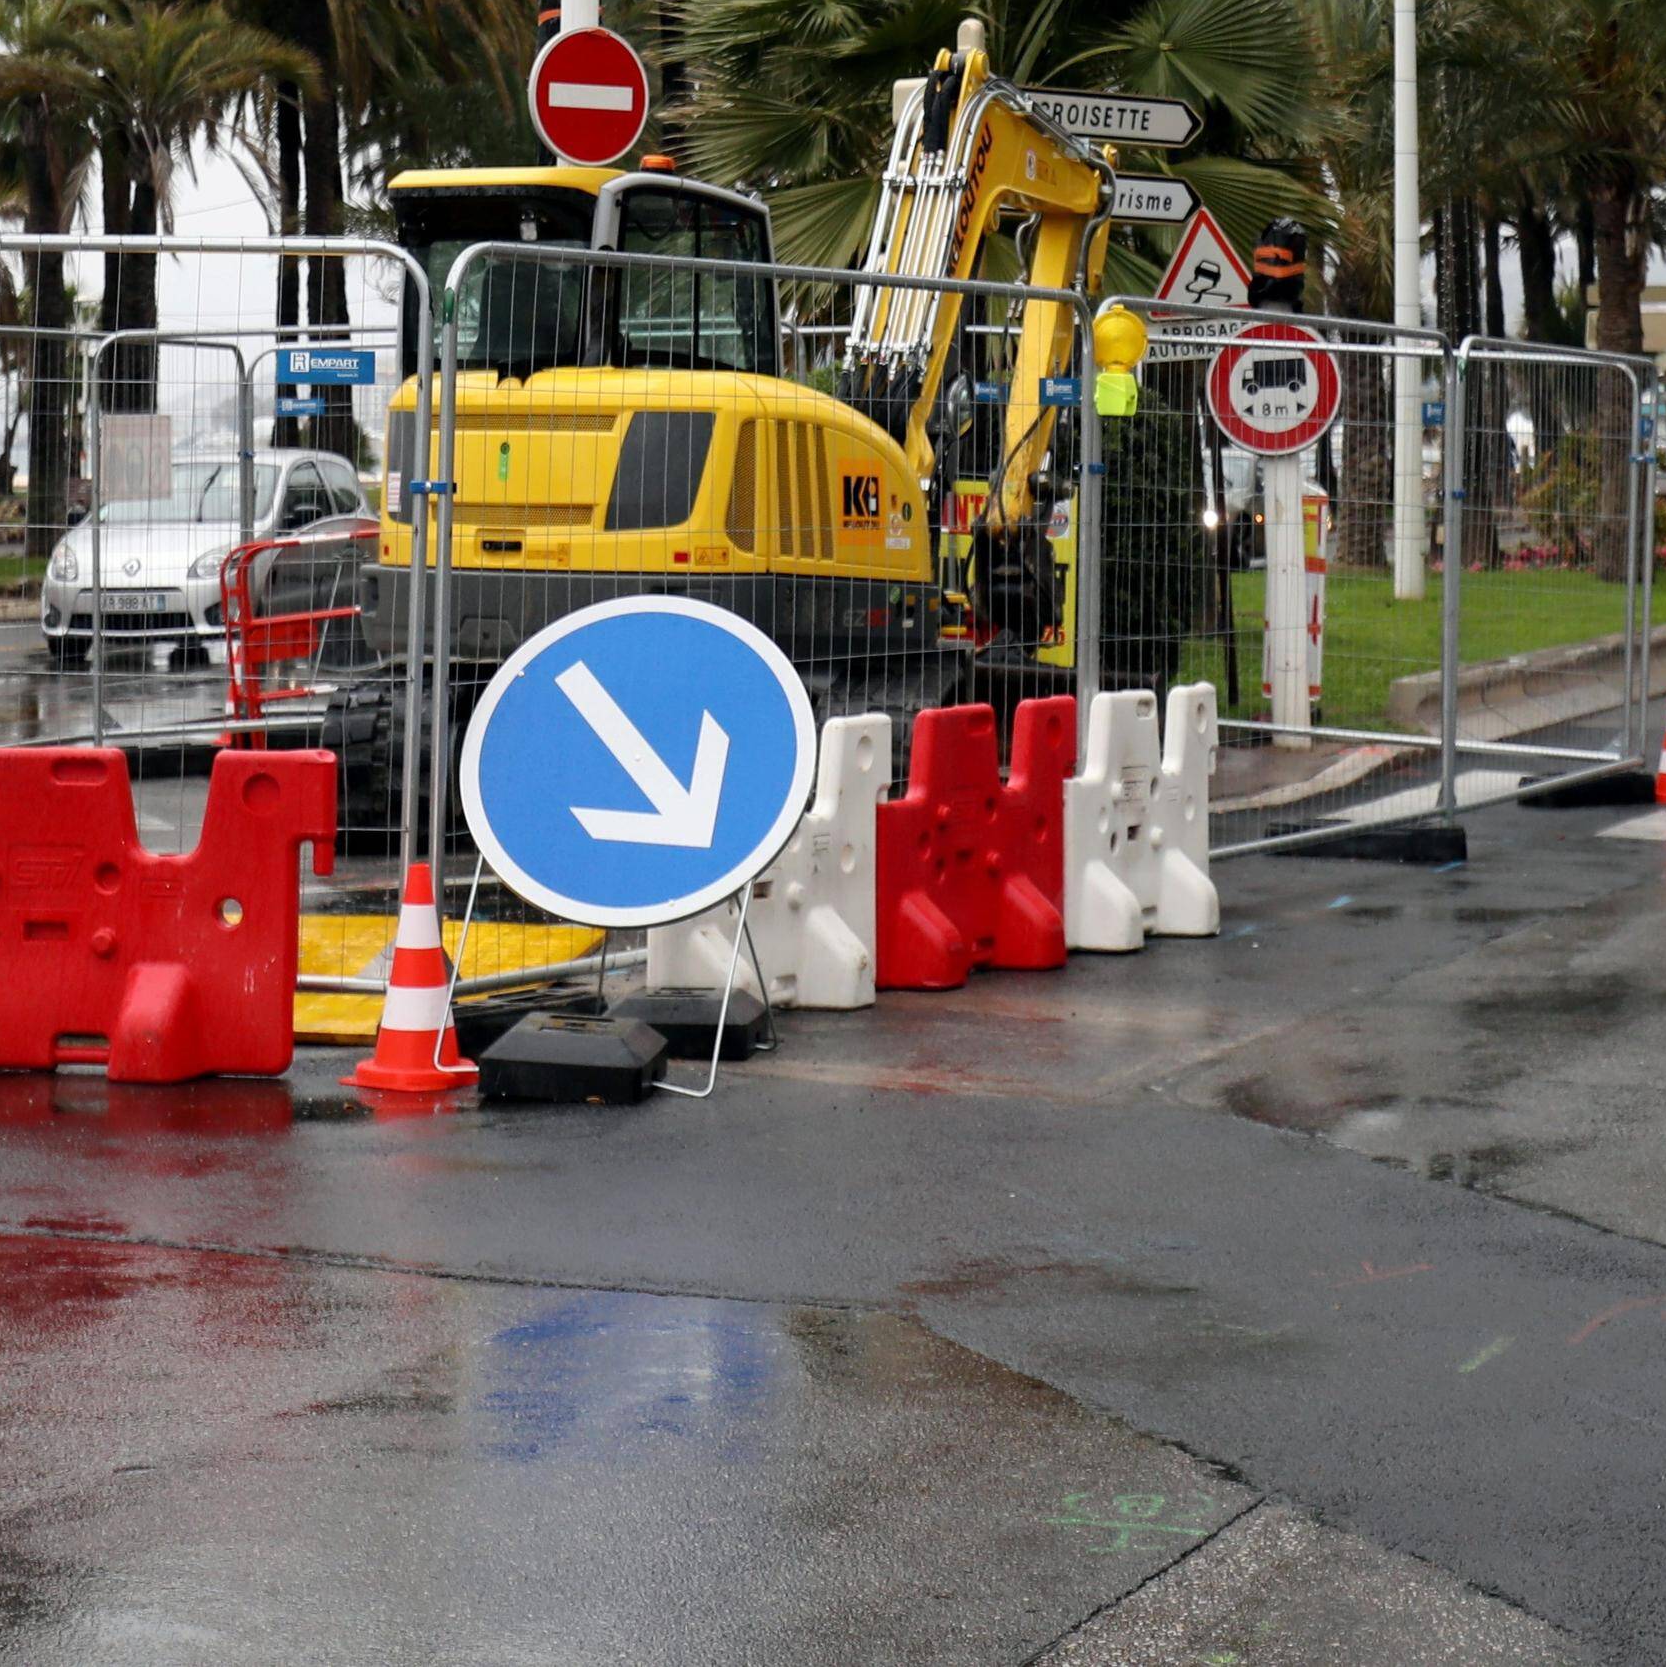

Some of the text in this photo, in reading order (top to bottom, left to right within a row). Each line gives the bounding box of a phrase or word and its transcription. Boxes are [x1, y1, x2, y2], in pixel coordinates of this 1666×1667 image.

[1161, 322, 1247, 338] ARROSAG
[1262, 403, 1288, 416] 8 m
